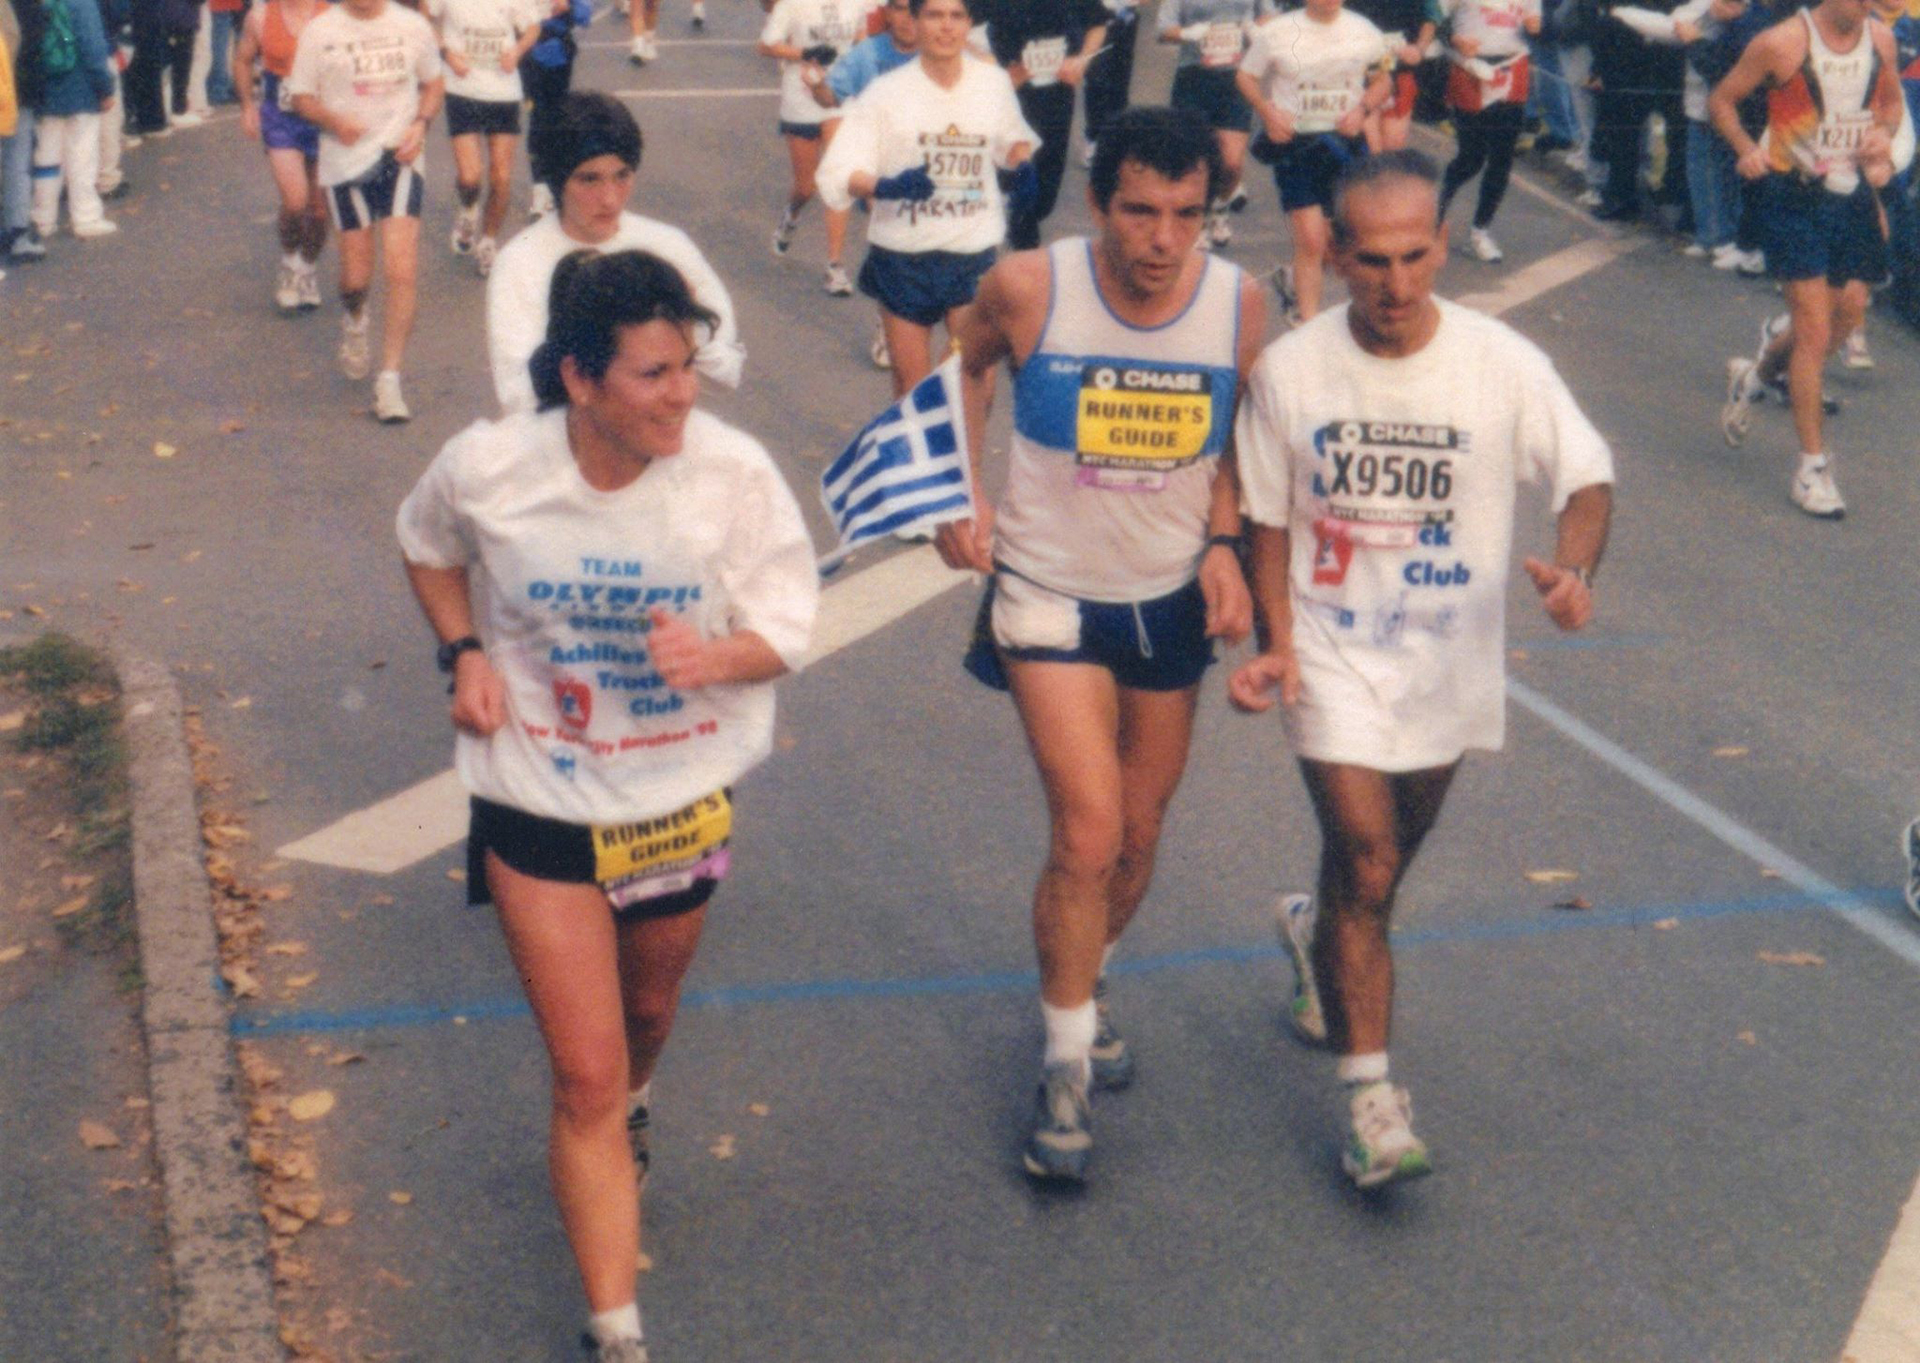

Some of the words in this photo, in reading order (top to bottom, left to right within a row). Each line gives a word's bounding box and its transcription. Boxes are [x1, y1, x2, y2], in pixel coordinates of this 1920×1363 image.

[1123, 369, 1203, 391] CHASE
[1085, 400, 1205, 425] RUNNER'S
[1108, 426, 1180, 448] GUIDE
[1367, 422, 1451, 447] CHASE
[1330, 451, 1454, 501] X9506
[581, 558, 642, 577] TEAM
[1403, 560, 1472, 586] Club
[549, 641, 648, 666] Achilles
[629, 693, 685, 717] Club
[619, 730, 690, 750] Marathon
[600, 793, 721, 849] RUNNER'S
[630, 829, 700, 863] GUIDE
